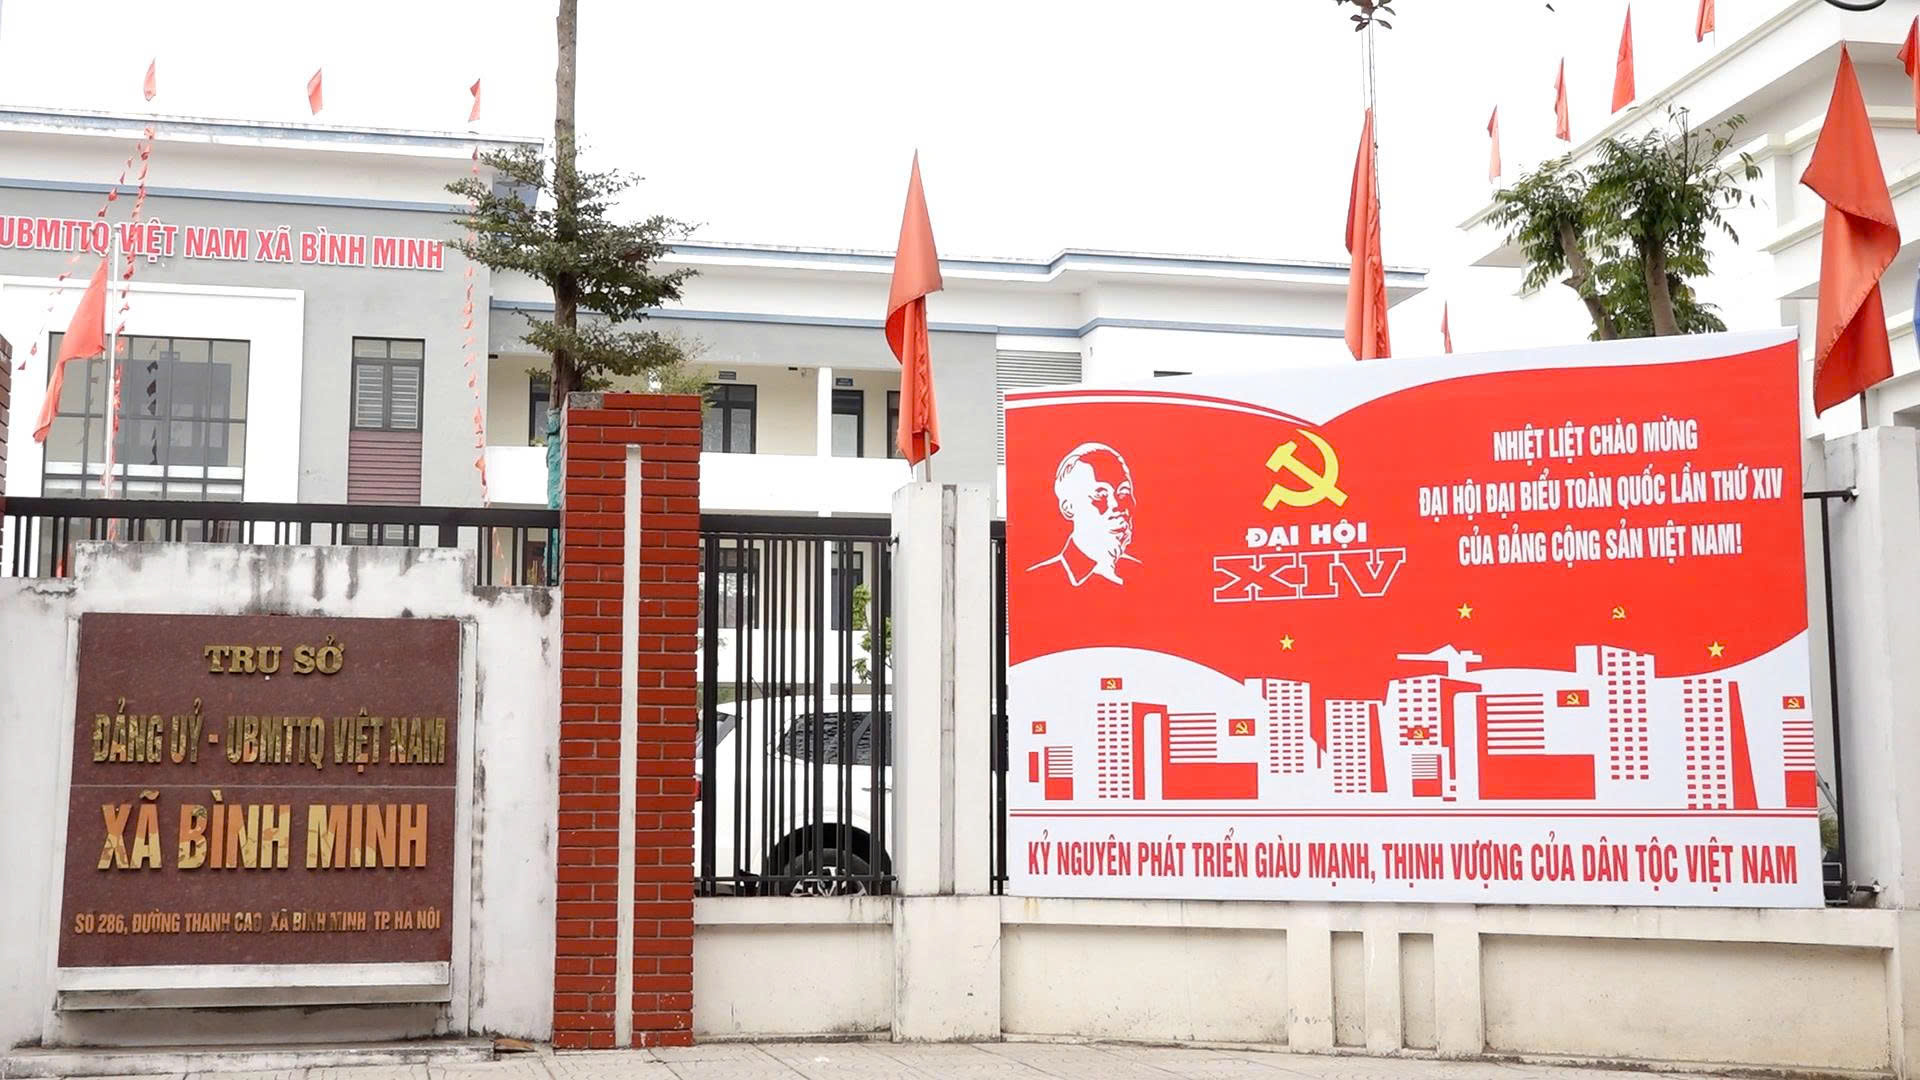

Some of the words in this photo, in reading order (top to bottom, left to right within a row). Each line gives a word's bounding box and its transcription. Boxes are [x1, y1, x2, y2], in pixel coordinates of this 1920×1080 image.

[0, 216, 110, 257] UBMTTQ
[119, 217, 178, 263] VIỆT
[184, 226, 248, 261] NAM
[255, 224, 293, 263] XÃ
[300, 226, 366, 267] BÌNH
[372, 235, 445, 271] MINH
[1493, 423, 1544, 466] NHIỆT
[1549, 421, 1585, 464] LIỆT
[1589, 417, 1637, 456] CHÀO
[1643, 415, 1698, 452] MỪNG
[1418, 482, 1448, 522] ĐẠI
[1452, 478, 1481, 520] HỘI
[1486, 481, 1516, 519] ĐẠI
[1520, 468, 1560, 511] BIỂU
[1565, 471, 1612, 509] TOÀN
[1617, 464, 1666, 509] QUỐC
[1670, 461, 1706, 504] LẦN
[1711, 463, 1748, 502] THỨ
[1752, 468, 1783, 500] XIV
[1246, 525, 1299, 551] ĐẠI
[1311, 518, 1367, 549] HỘI
[1459, 525, 1494, 566] CỦA
[1498, 523, 1546, 564] ĐẢNG
[1551, 524, 1600, 568] CỘNG
[1605, 518, 1643, 560] SẢN
[1647, 519, 1686, 563] VIỆT
[1691, 523, 1743, 556] NAM!
[1213, 547, 1406, 603] XIV
[204, 644, 282, 681] TRỤ
[293, 634, 345, 675] SỞ
[92, 697, 163, 763] ĐẢNG
[170, 697, 205, 764] UỶ
[207, 733, 219, 744] -
[226, 716, 325, 769] UBMTTQ
[333, 706, 384, 773] VIỆT
[389, 716, 446, 764] NAM
[97, 789, 162, 869] XÃ
[177, 789, 291, 869] BÌNH
[306, 803, 428, 869] MINH
[1028, 829, 1051, 875] KỶ
[1057, 834, 1131, 877] NGUYÊN
[1137, 834, 1186, 877] PHÁT
[1192, 827, 1248, 878] TRIỂN
[1255, 835, 1301, 879] GIÀU
[1308, 842, 1376, 887] MẠNH,
[1382, 843, 1443, 888] THỊNH
[1451, 840, 1523, 889] VƯỢNG
[1531, 831, 1575, 882] CỦA
[1583, 836, 1628, 882] DÂN
[1635, 837, 1678, 892] TỘC
[1685, 837, 1733, 892] VIỆT
[1742, 845, 1798, 884] NAM
[97, 913, 128, 935] 286,
[184, 911, 230, 933] THANH
